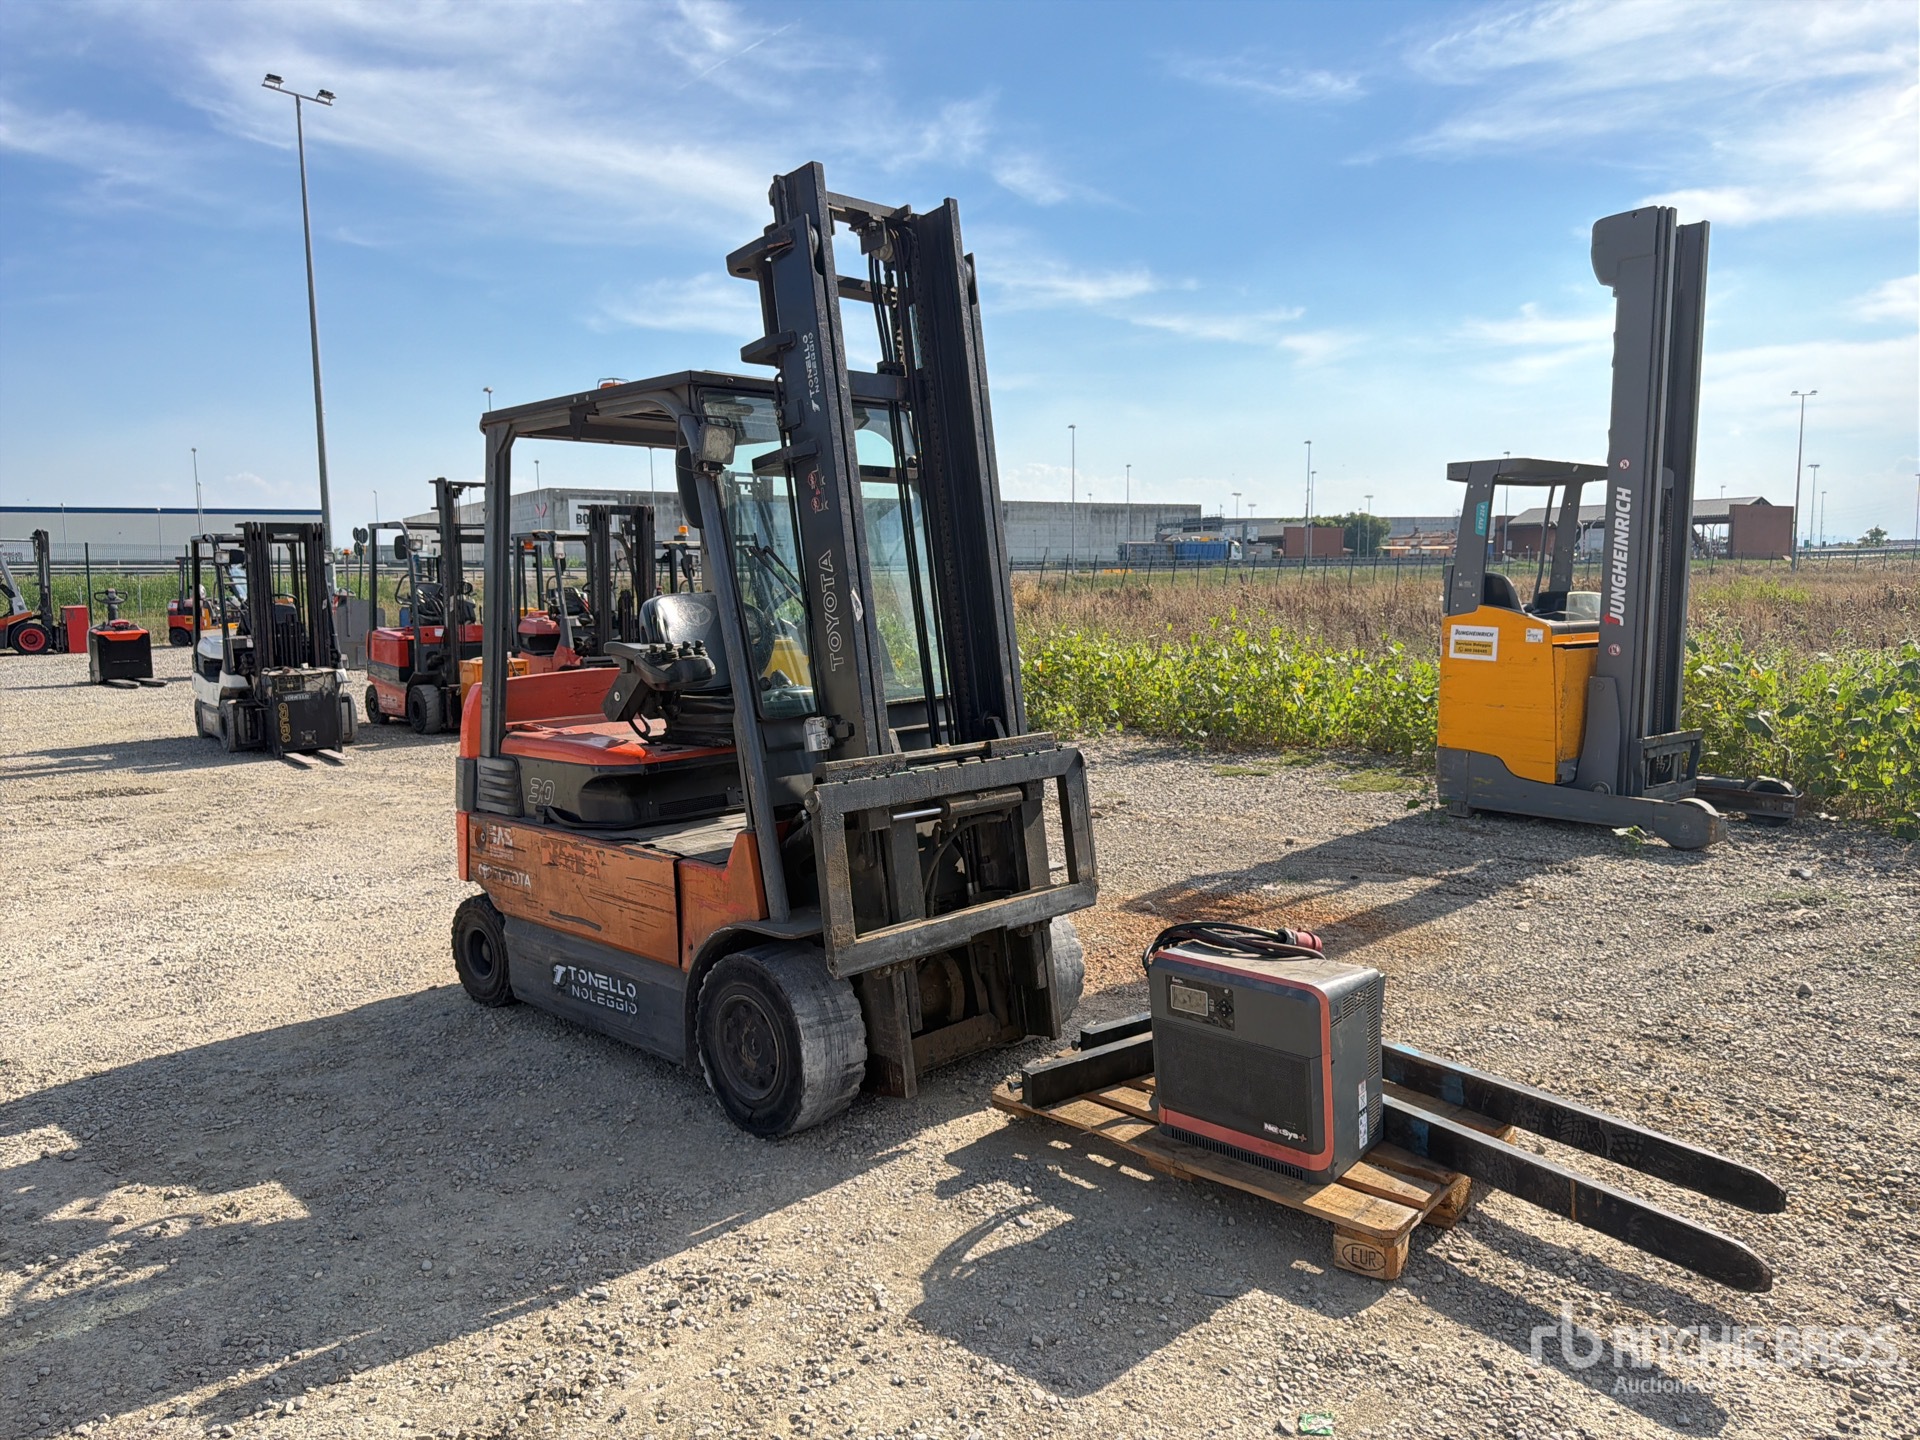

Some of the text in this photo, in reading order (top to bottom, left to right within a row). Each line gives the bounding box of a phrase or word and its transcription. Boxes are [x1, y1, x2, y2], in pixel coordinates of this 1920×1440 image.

[803, 335, 815, 398] TONELLO
[808, 332, 820, 393] NOLEGGIO
[1603, 487, 1632, 627] JUNGHEINRICH
[818, 549, 844, 671] TOYOTA
[1455, 628, 1494, 638] JUNGHEINRICH
[527, 777, 555, 806] 30
[567, 965, 637, 998] TONELLO
[571, 984, 638, 1015] NOLEGGIO
[1351, 1246, 1376, 1268] EUR
